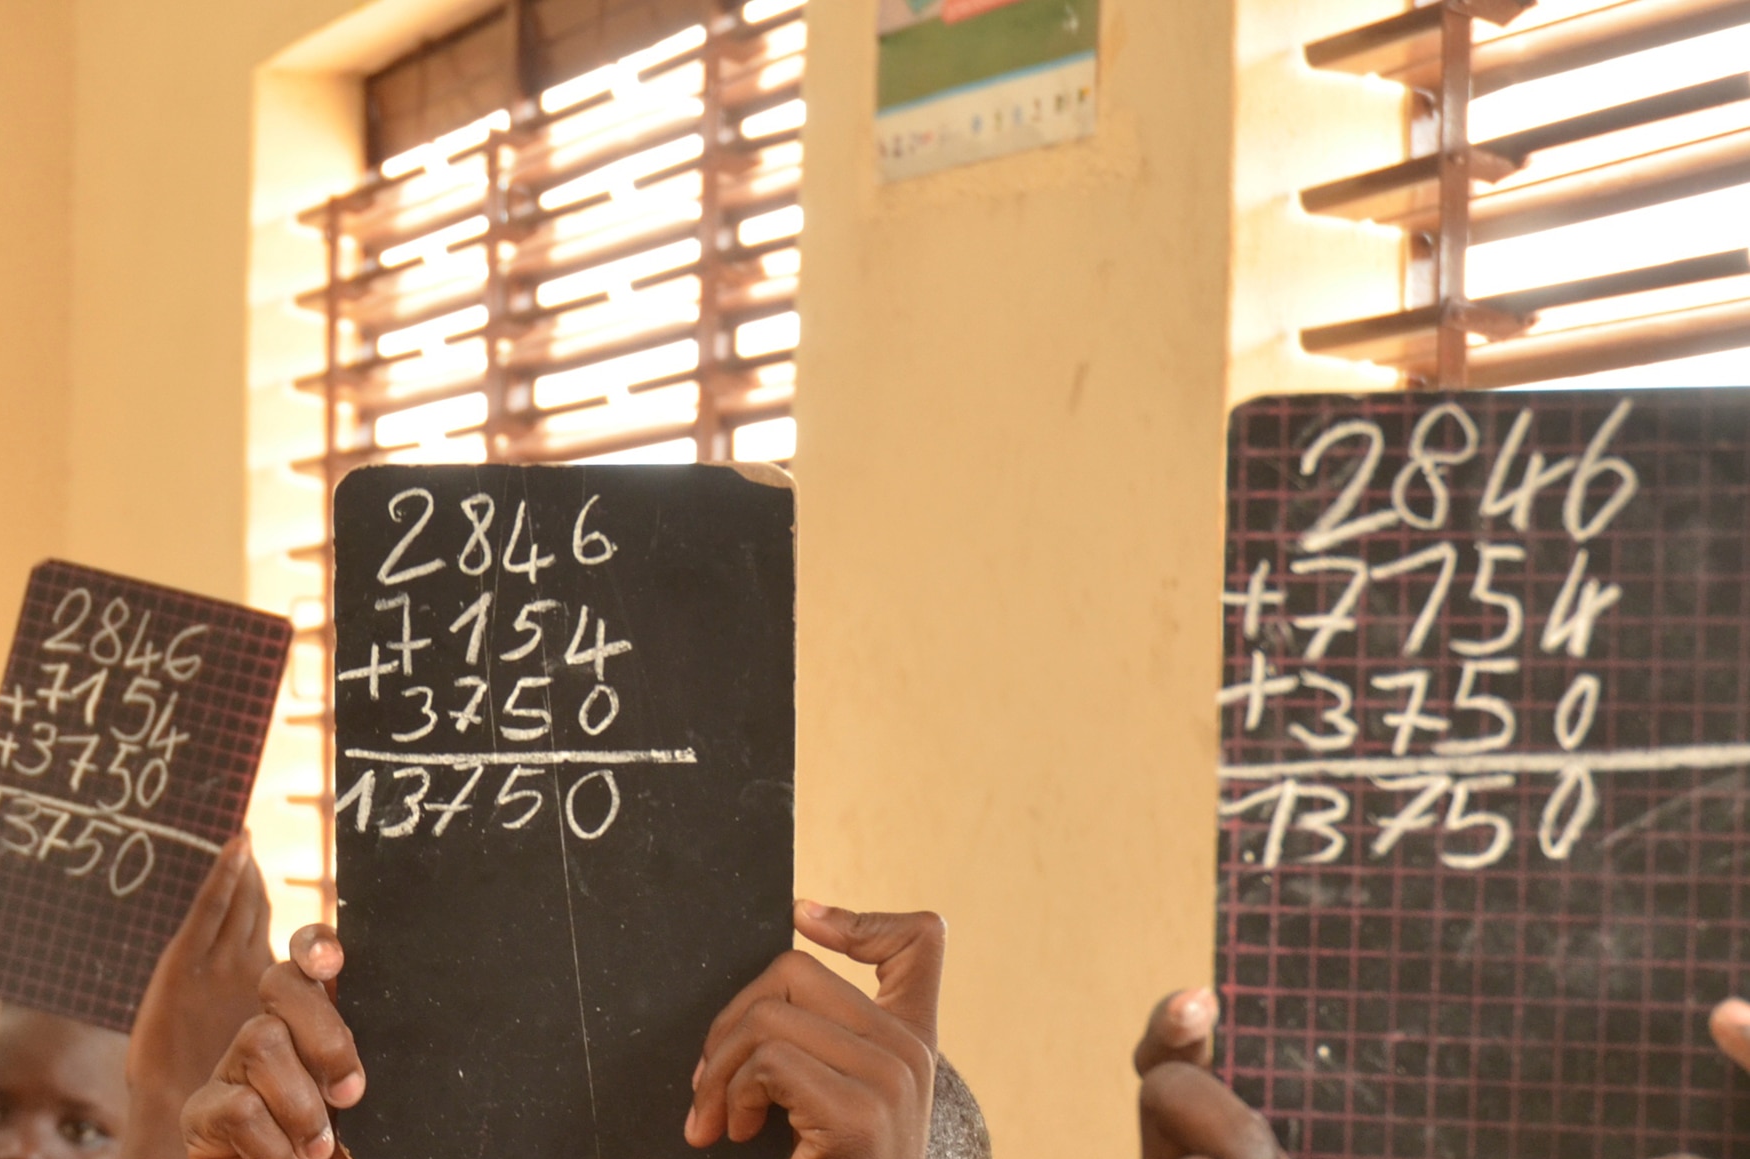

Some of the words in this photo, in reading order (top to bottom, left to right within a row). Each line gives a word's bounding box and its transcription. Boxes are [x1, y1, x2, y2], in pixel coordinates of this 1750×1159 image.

[1301, 398, 1639, 552] 2846
[377, 487, 618, 585] 2846
[42, 587, 209, 681] 2846
[391, 676, 620, 742] 3750
[335, 764, 620, 840] 13750
[1218, 765, 1597, 870] 13750
